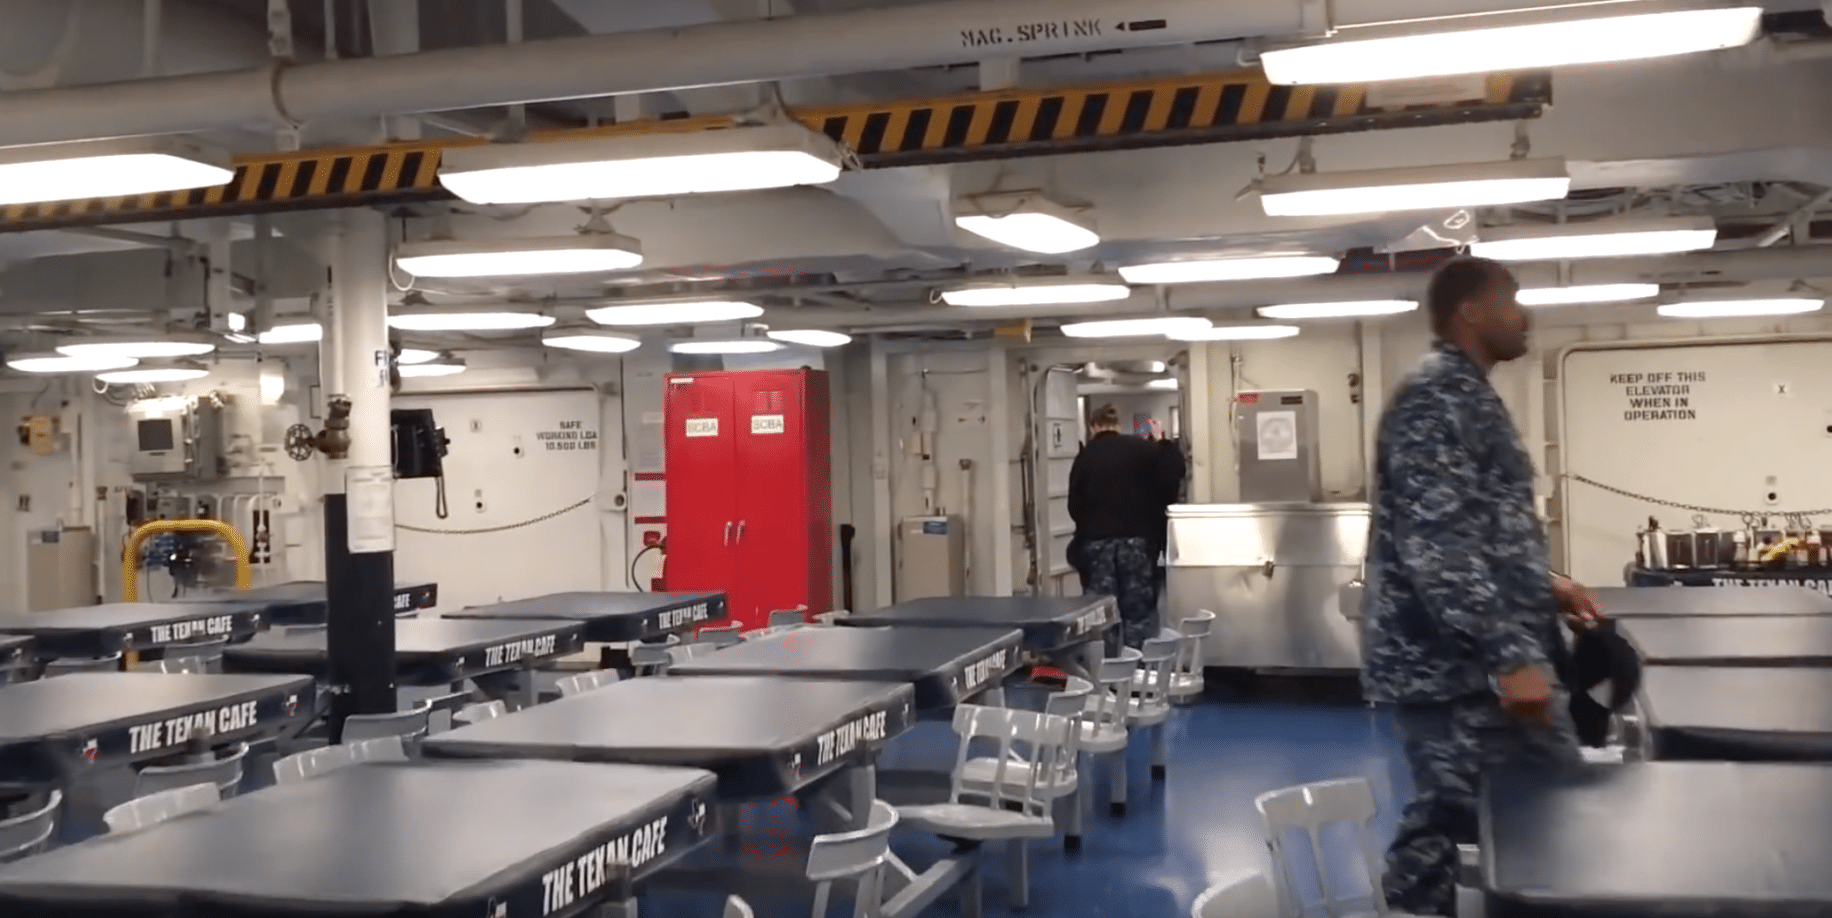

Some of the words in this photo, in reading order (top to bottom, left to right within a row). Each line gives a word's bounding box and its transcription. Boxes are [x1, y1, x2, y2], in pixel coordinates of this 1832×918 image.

[1610, 373, 1643, 384] KEEP
[1647, 372, 1672, 383] OFF
[1677, 371, 1706, 382] THIS
[1626, 385, 1690, 396] ELEVATOR
[1630, 397, 1671, 409] WHEN
[1675, 397, 1689, 408] IN
[1624, 409, 1696, 421] OPERATION
[559, 420, 582, 430] SAFE
[151, 625, 171, 643] THE
[207, 615, 233, 635] CAFE
[485, 645, 504, 667] THE
[128, 722, 162, 754] THE
[219, 700, 257, 733] CAFE
[818, 730, 836, 766] THE
[542, 861, 575, 917] THE
[632, 815, 668, 868] CAFE
